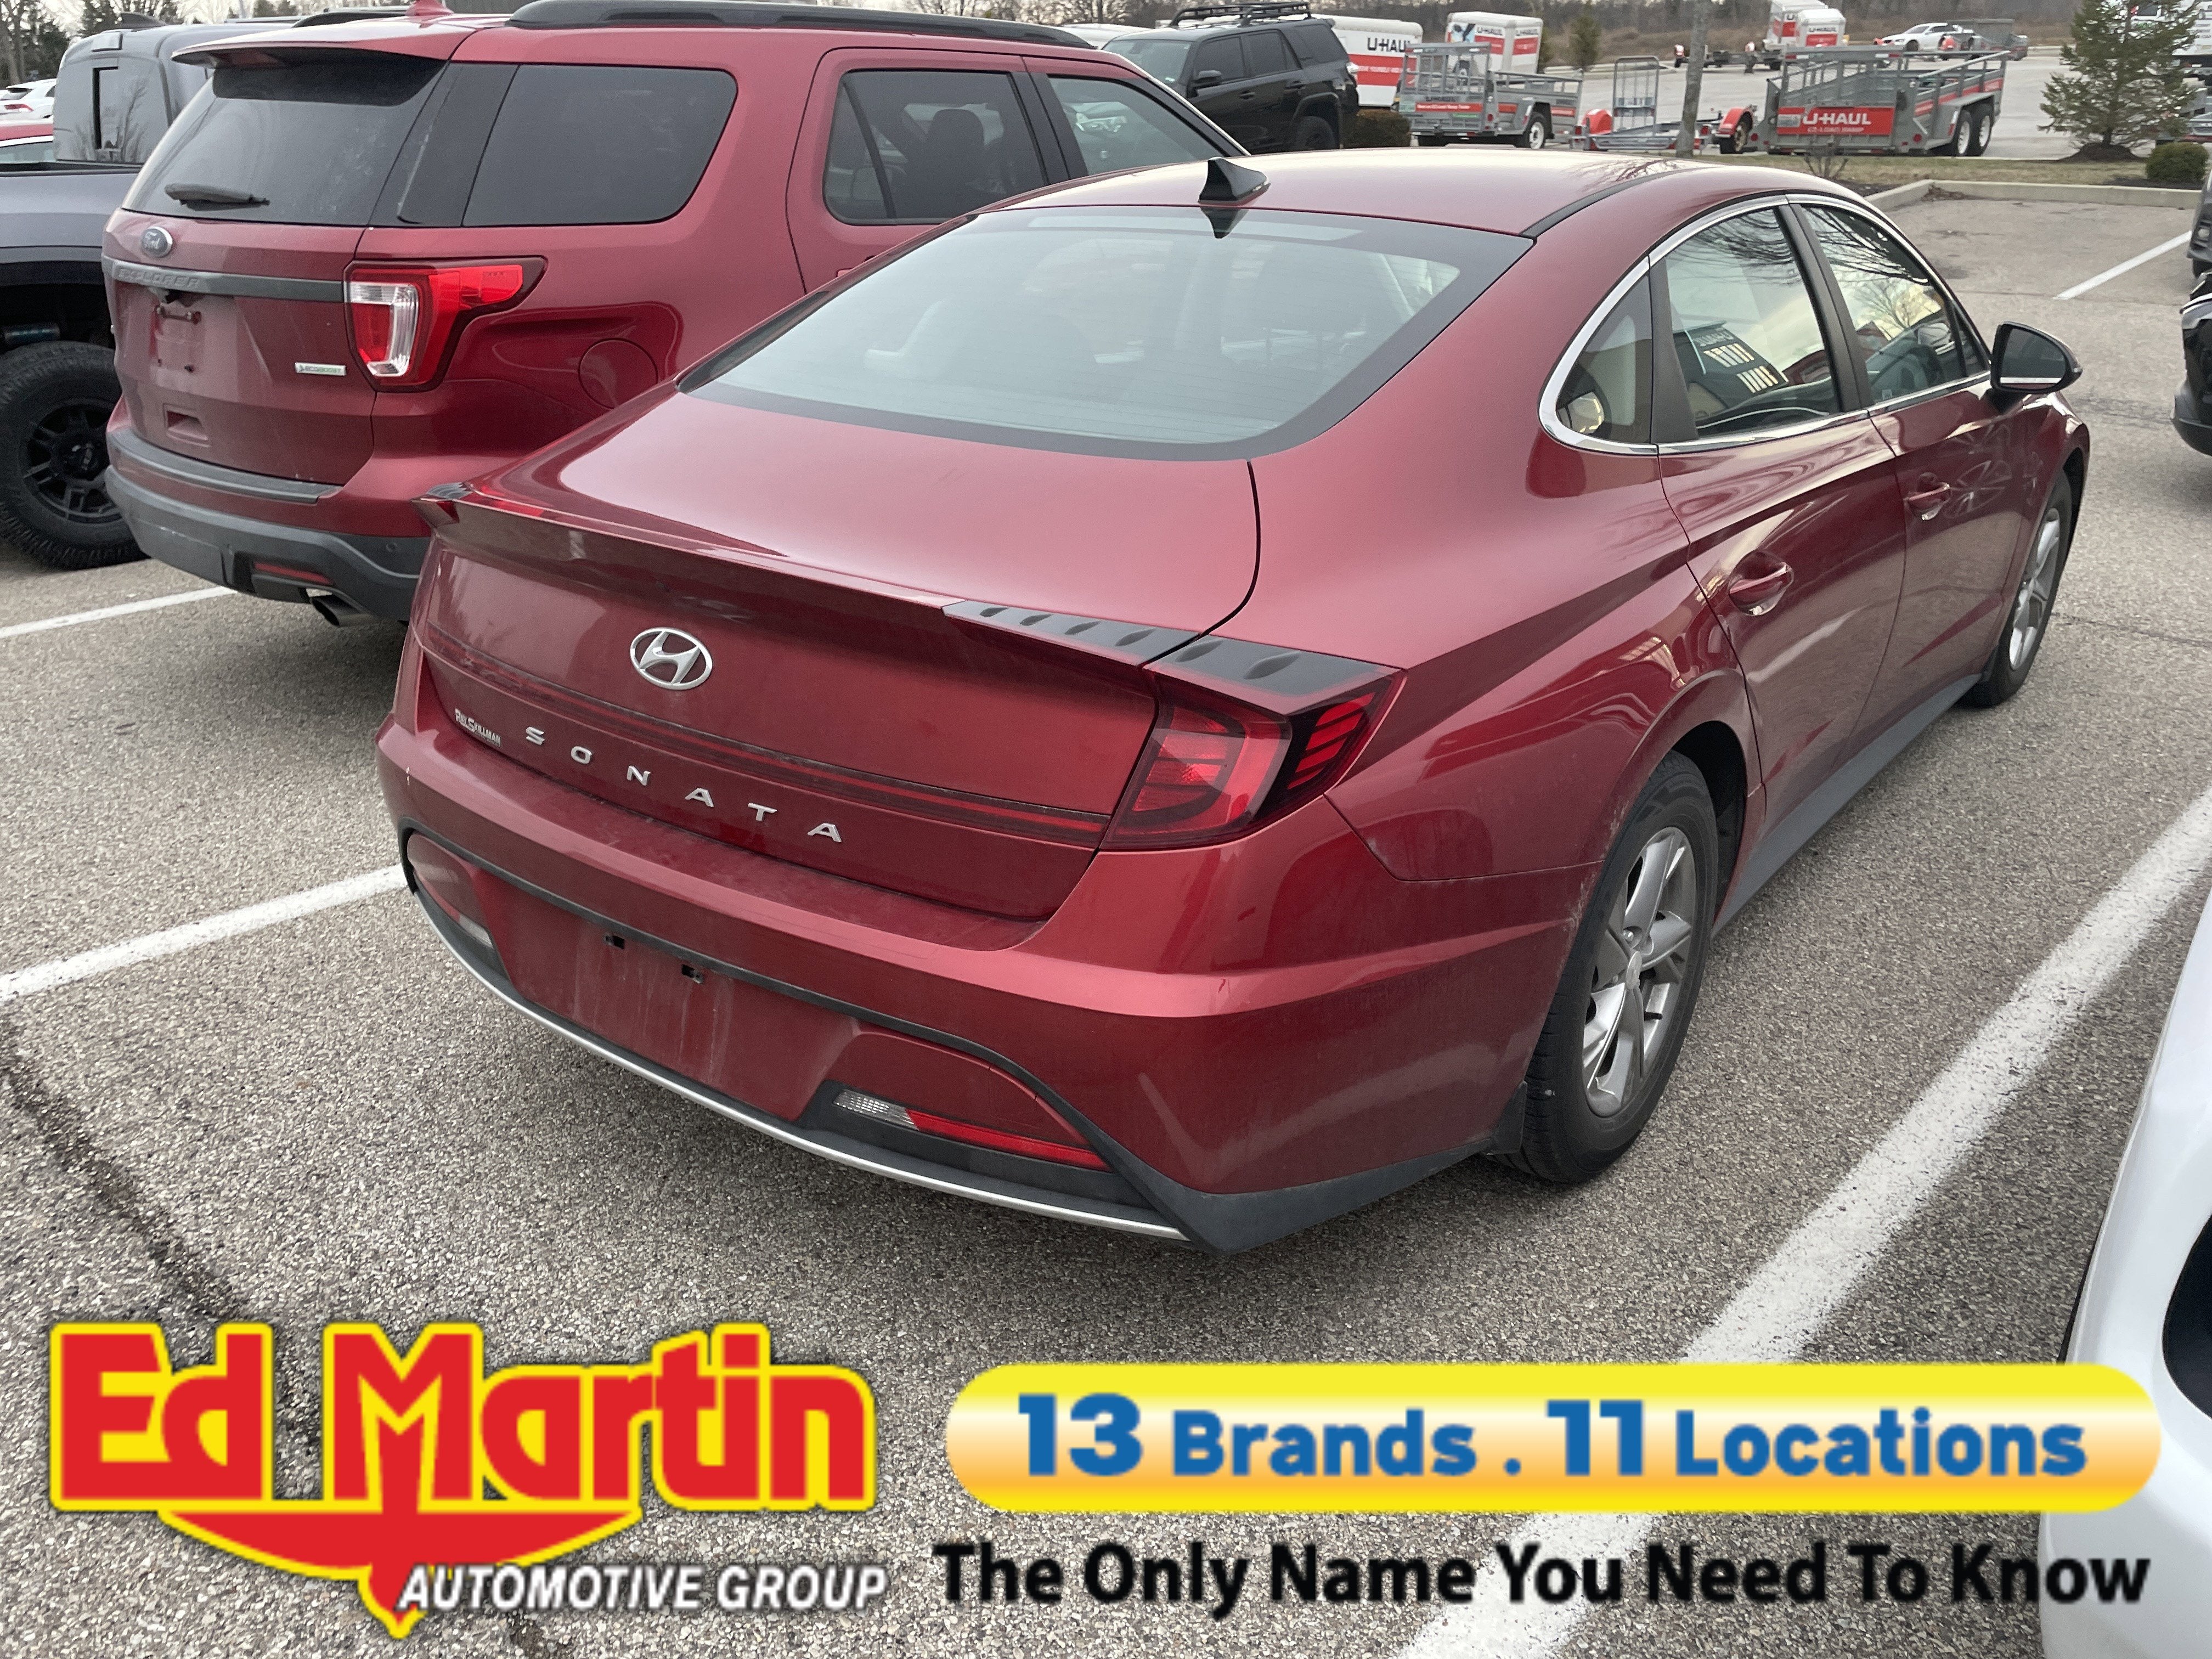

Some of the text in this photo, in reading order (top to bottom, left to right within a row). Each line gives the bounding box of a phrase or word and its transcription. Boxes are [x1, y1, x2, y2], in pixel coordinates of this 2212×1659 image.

[1367, 37, 1410, 53] U-HAU
[1802, 112, 1872, 126] U-HAUL
[525, 726, 842, 843] SONATA
